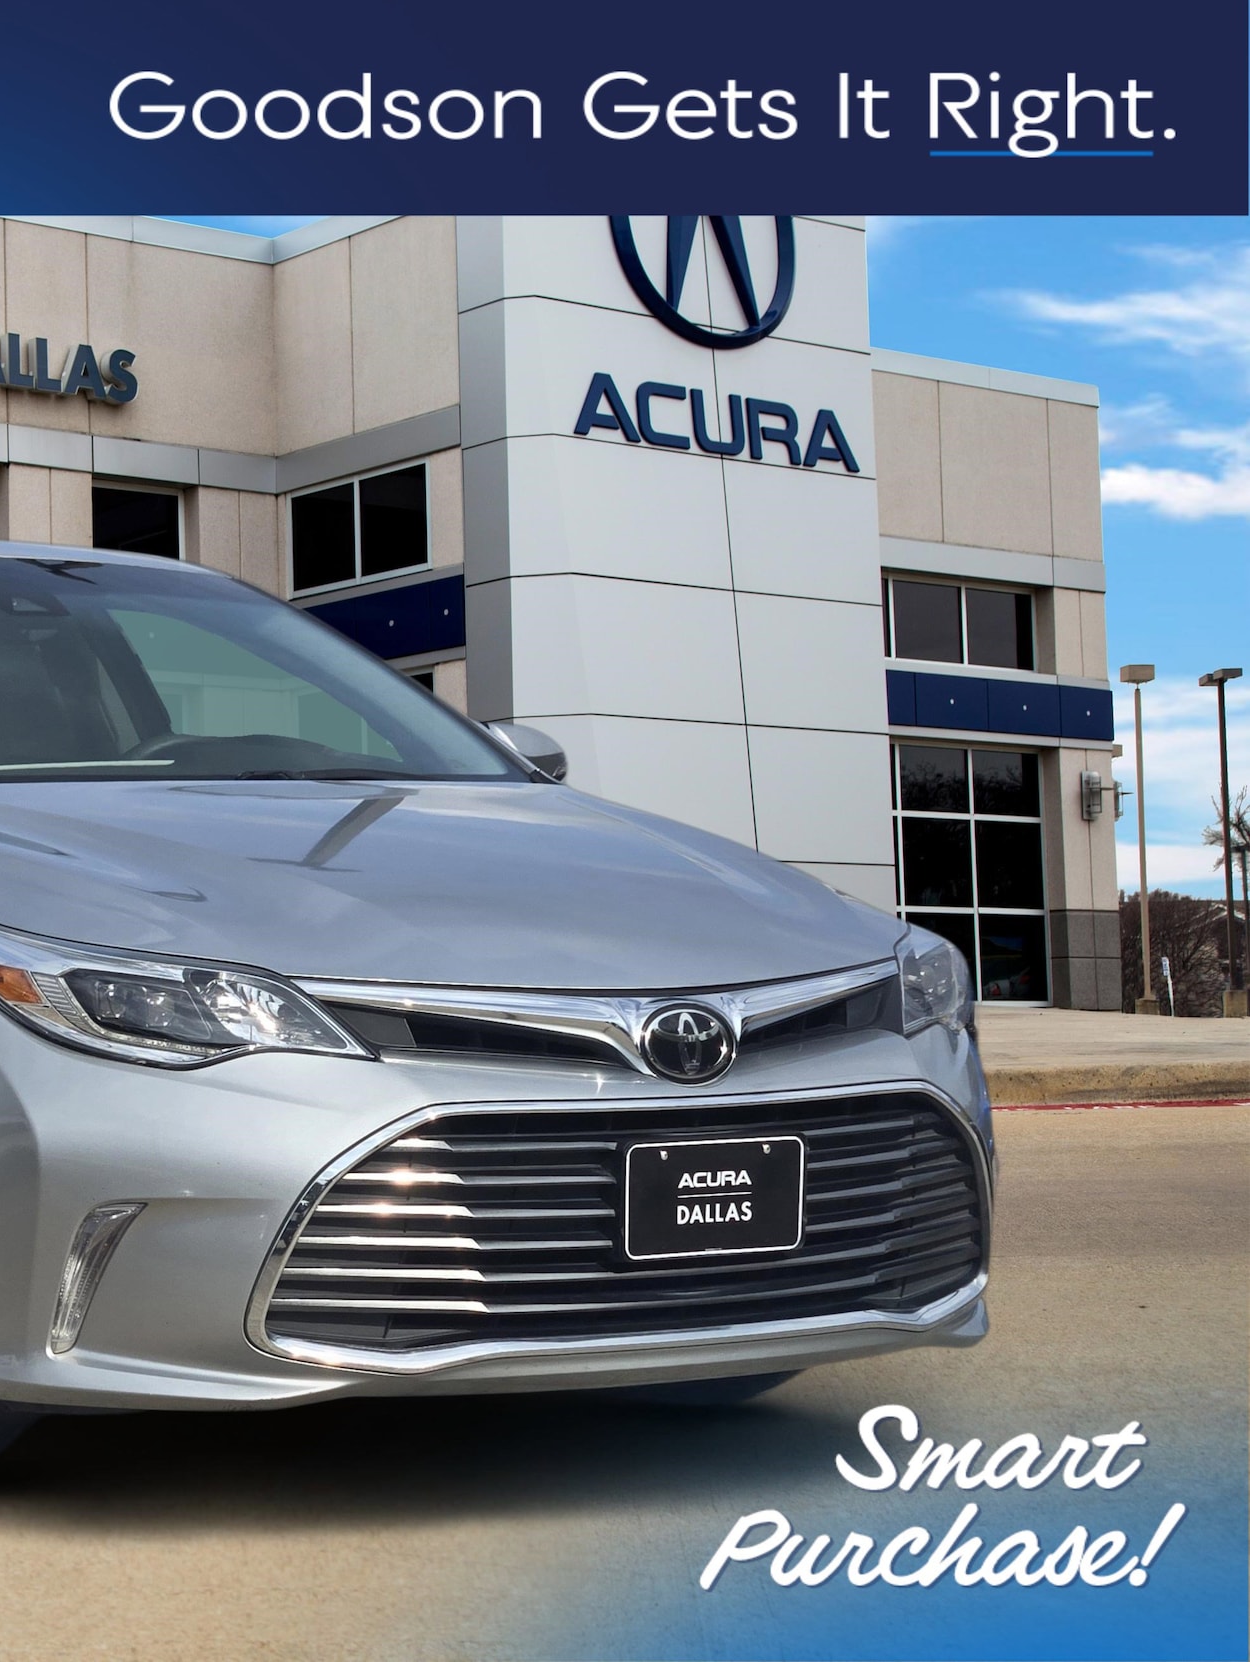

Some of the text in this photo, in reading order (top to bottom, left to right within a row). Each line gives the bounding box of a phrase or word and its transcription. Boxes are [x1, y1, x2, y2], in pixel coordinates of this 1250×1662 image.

[573, 371, 861, 474] ACURA
[677, 1169, 752, 1189] ACURA
[676, 1201, 753, 1225] DALLAS
